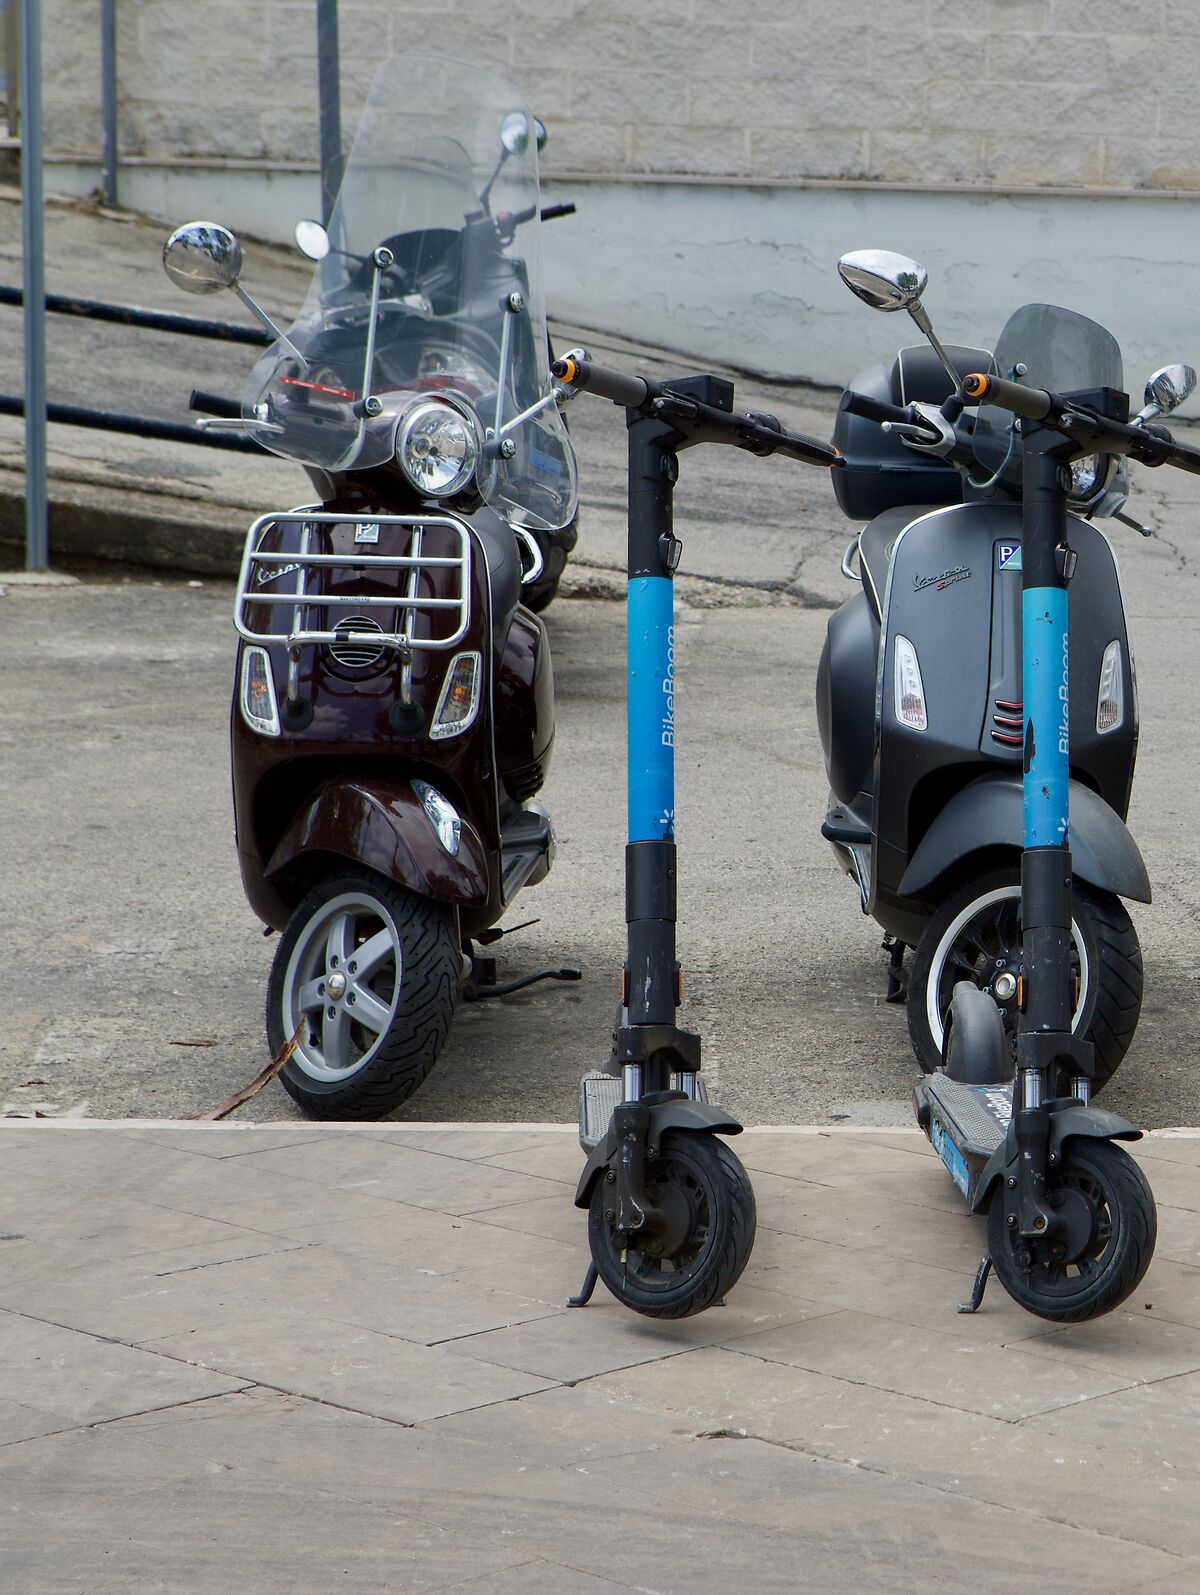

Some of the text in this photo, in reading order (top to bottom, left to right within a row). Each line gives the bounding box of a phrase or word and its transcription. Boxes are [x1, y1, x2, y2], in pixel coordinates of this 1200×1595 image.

[1000, 546, 1013, 562] P
[661, 626, 674, 748] BikeBoom
[1058, 632, 1069, 755] BikeBoom
